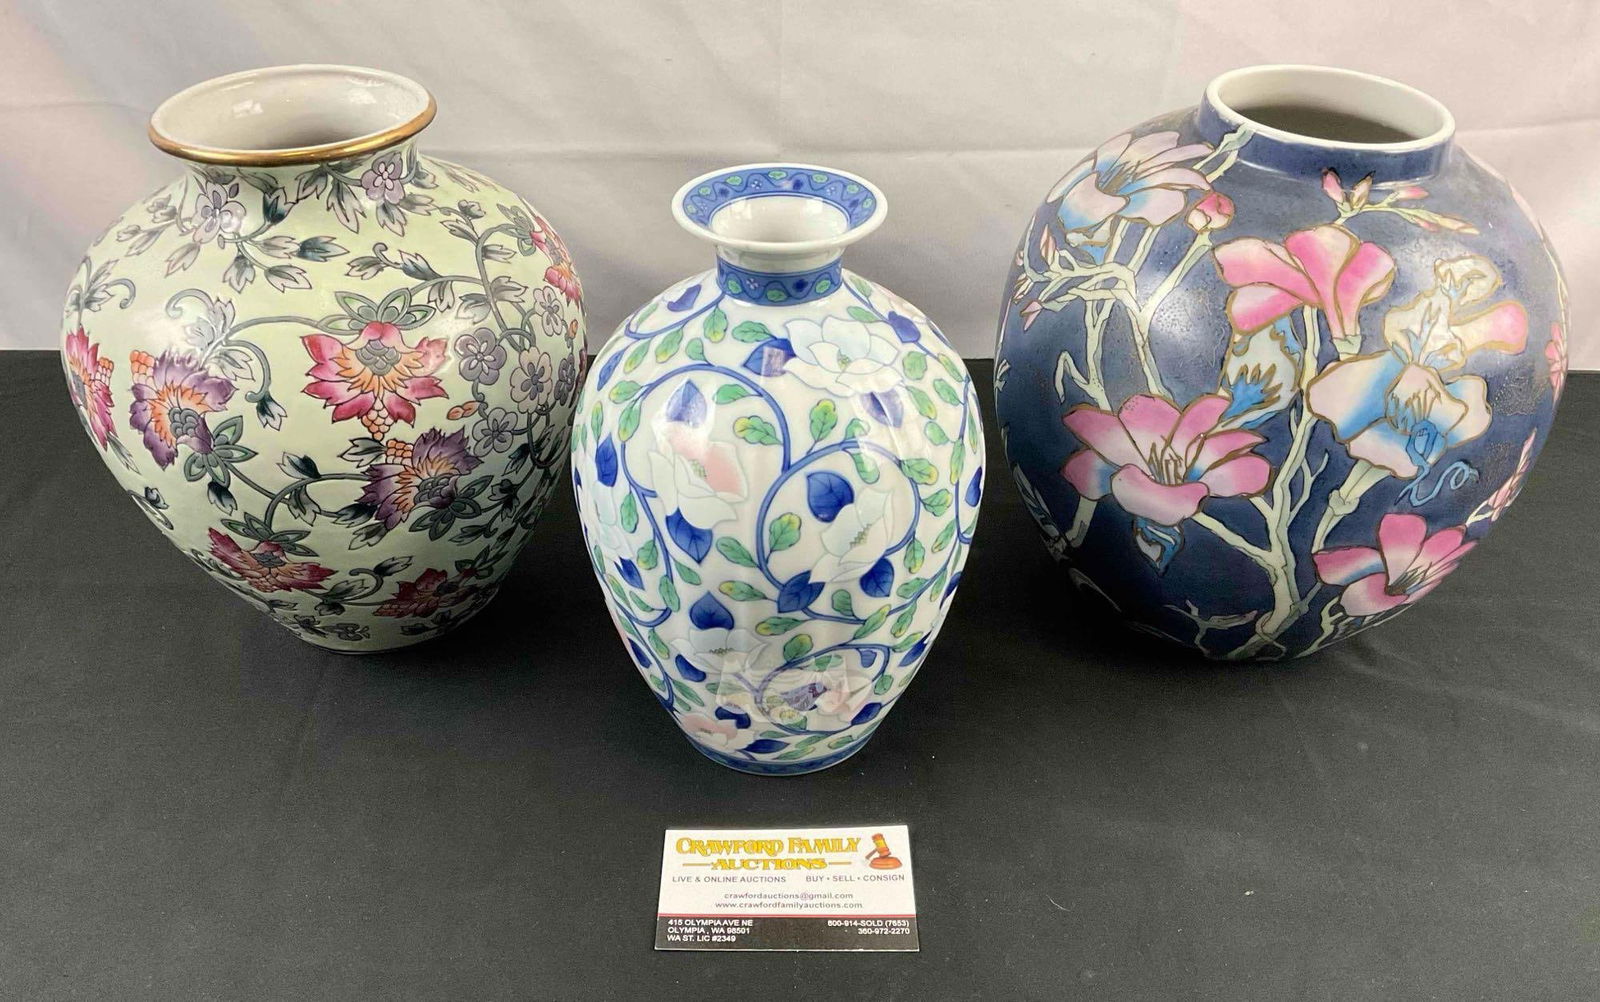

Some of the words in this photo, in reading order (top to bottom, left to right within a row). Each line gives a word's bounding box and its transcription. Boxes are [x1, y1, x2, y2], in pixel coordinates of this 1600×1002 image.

[676, 837, 784, 857] CRAWFORD
[788, 837, 861, 854] FAMILY
[711, 858, 828, 870] AUCTIONS
[724, 892, 854, 901] crawfordauctions@gmail.com
[858, 927, 910, 935] 360-972-2270
